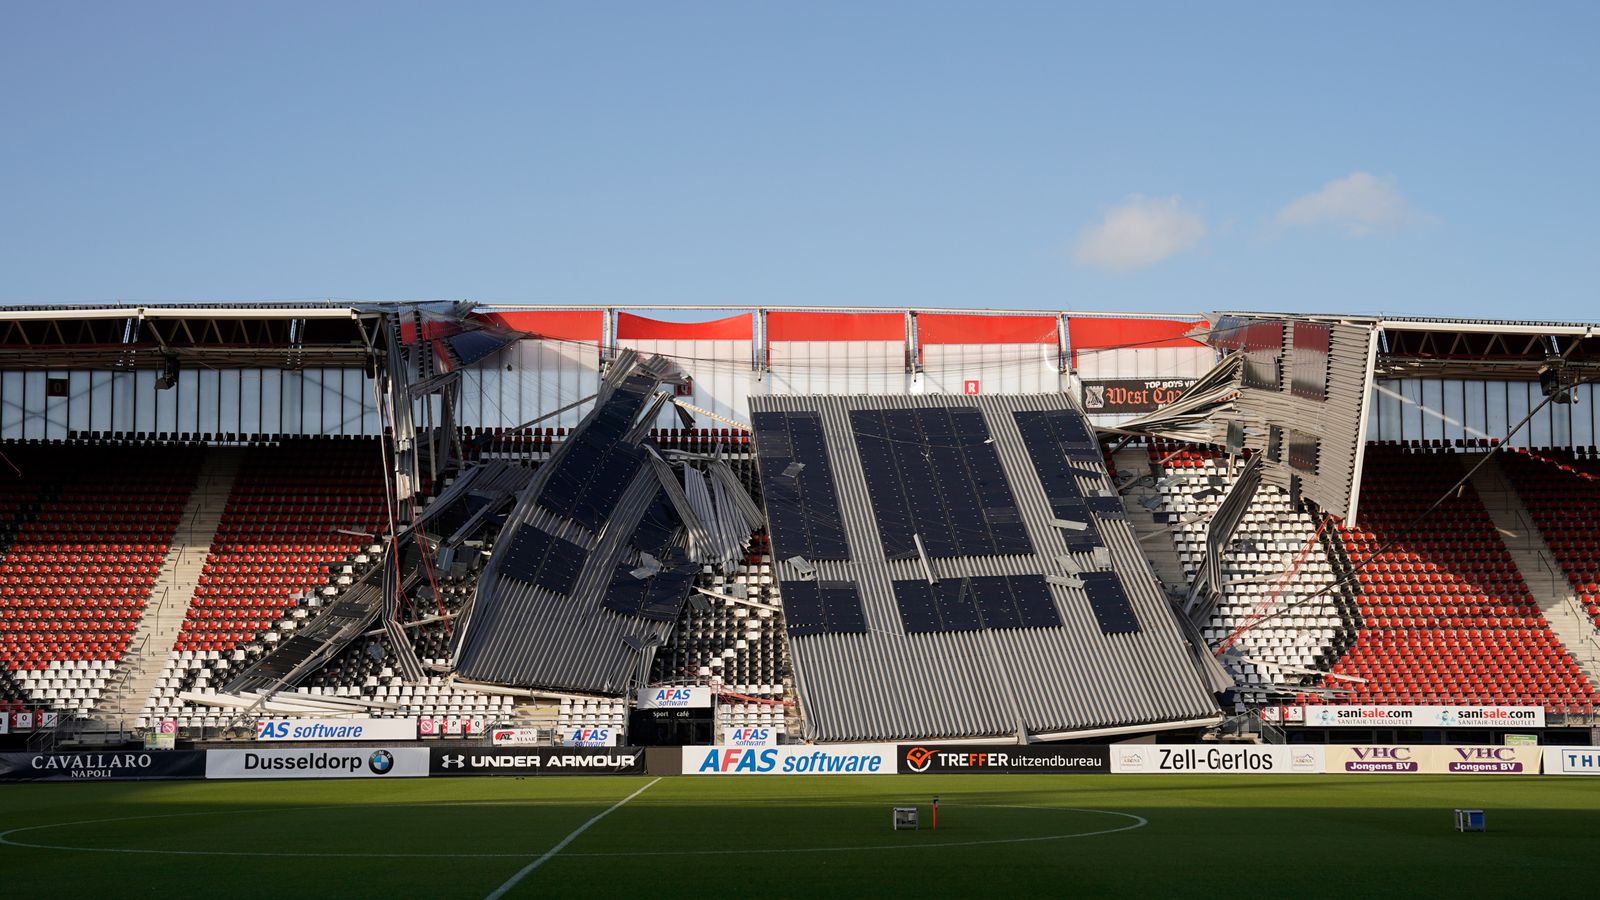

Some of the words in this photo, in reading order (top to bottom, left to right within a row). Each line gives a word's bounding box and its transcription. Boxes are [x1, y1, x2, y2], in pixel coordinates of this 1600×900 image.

[968, 382, 976, 393] R
[1144, 381, 1160, 389] TOP
[1162, 380, 1184, 389] BOYS
[1105, 387, 1150, 405] West
[656, 689, 691, 700] AFAS
[658, 699, 689, 707] software
[1337, 707, 1413, 718] sanisale.com
[1457, 708, 1536, 719] sanisale.com
[293, 723, 363, 738] software
[572, 729, 609, 741] AFAS
[732, 728, 769, 740] AFAS
[735, 738, 766, 746] software
[1159, 748, 1273, 770] Zell-Gerlos
[1351, 747, 1412, 761] VHC
[1454, 747, 1516, 761] VHC
[32, 754, 152, 769] CAVALLARO
[244, 752, 362, 772] Dusseldorp
[471, 755, 541, 767] UNDER
[546, 754, 635, 768] ARMOUR
[699, 749, 778, 772] AFAS
[782, 751, 882, 773] software
[938, 753, 1009, 767] TREFFER
[1011, 755, 1102, 768] uitzendbureau
[1350, 762, 1394, 771] Jongens
[1396, 762, 1411, 770] BV
[1568, 754, 1600, 767] TH
[71, 769, 112, 778] NAPOLI
[1454, 763, 1498, 772] Jongens
[1500, 763, 1516, 771] BV
